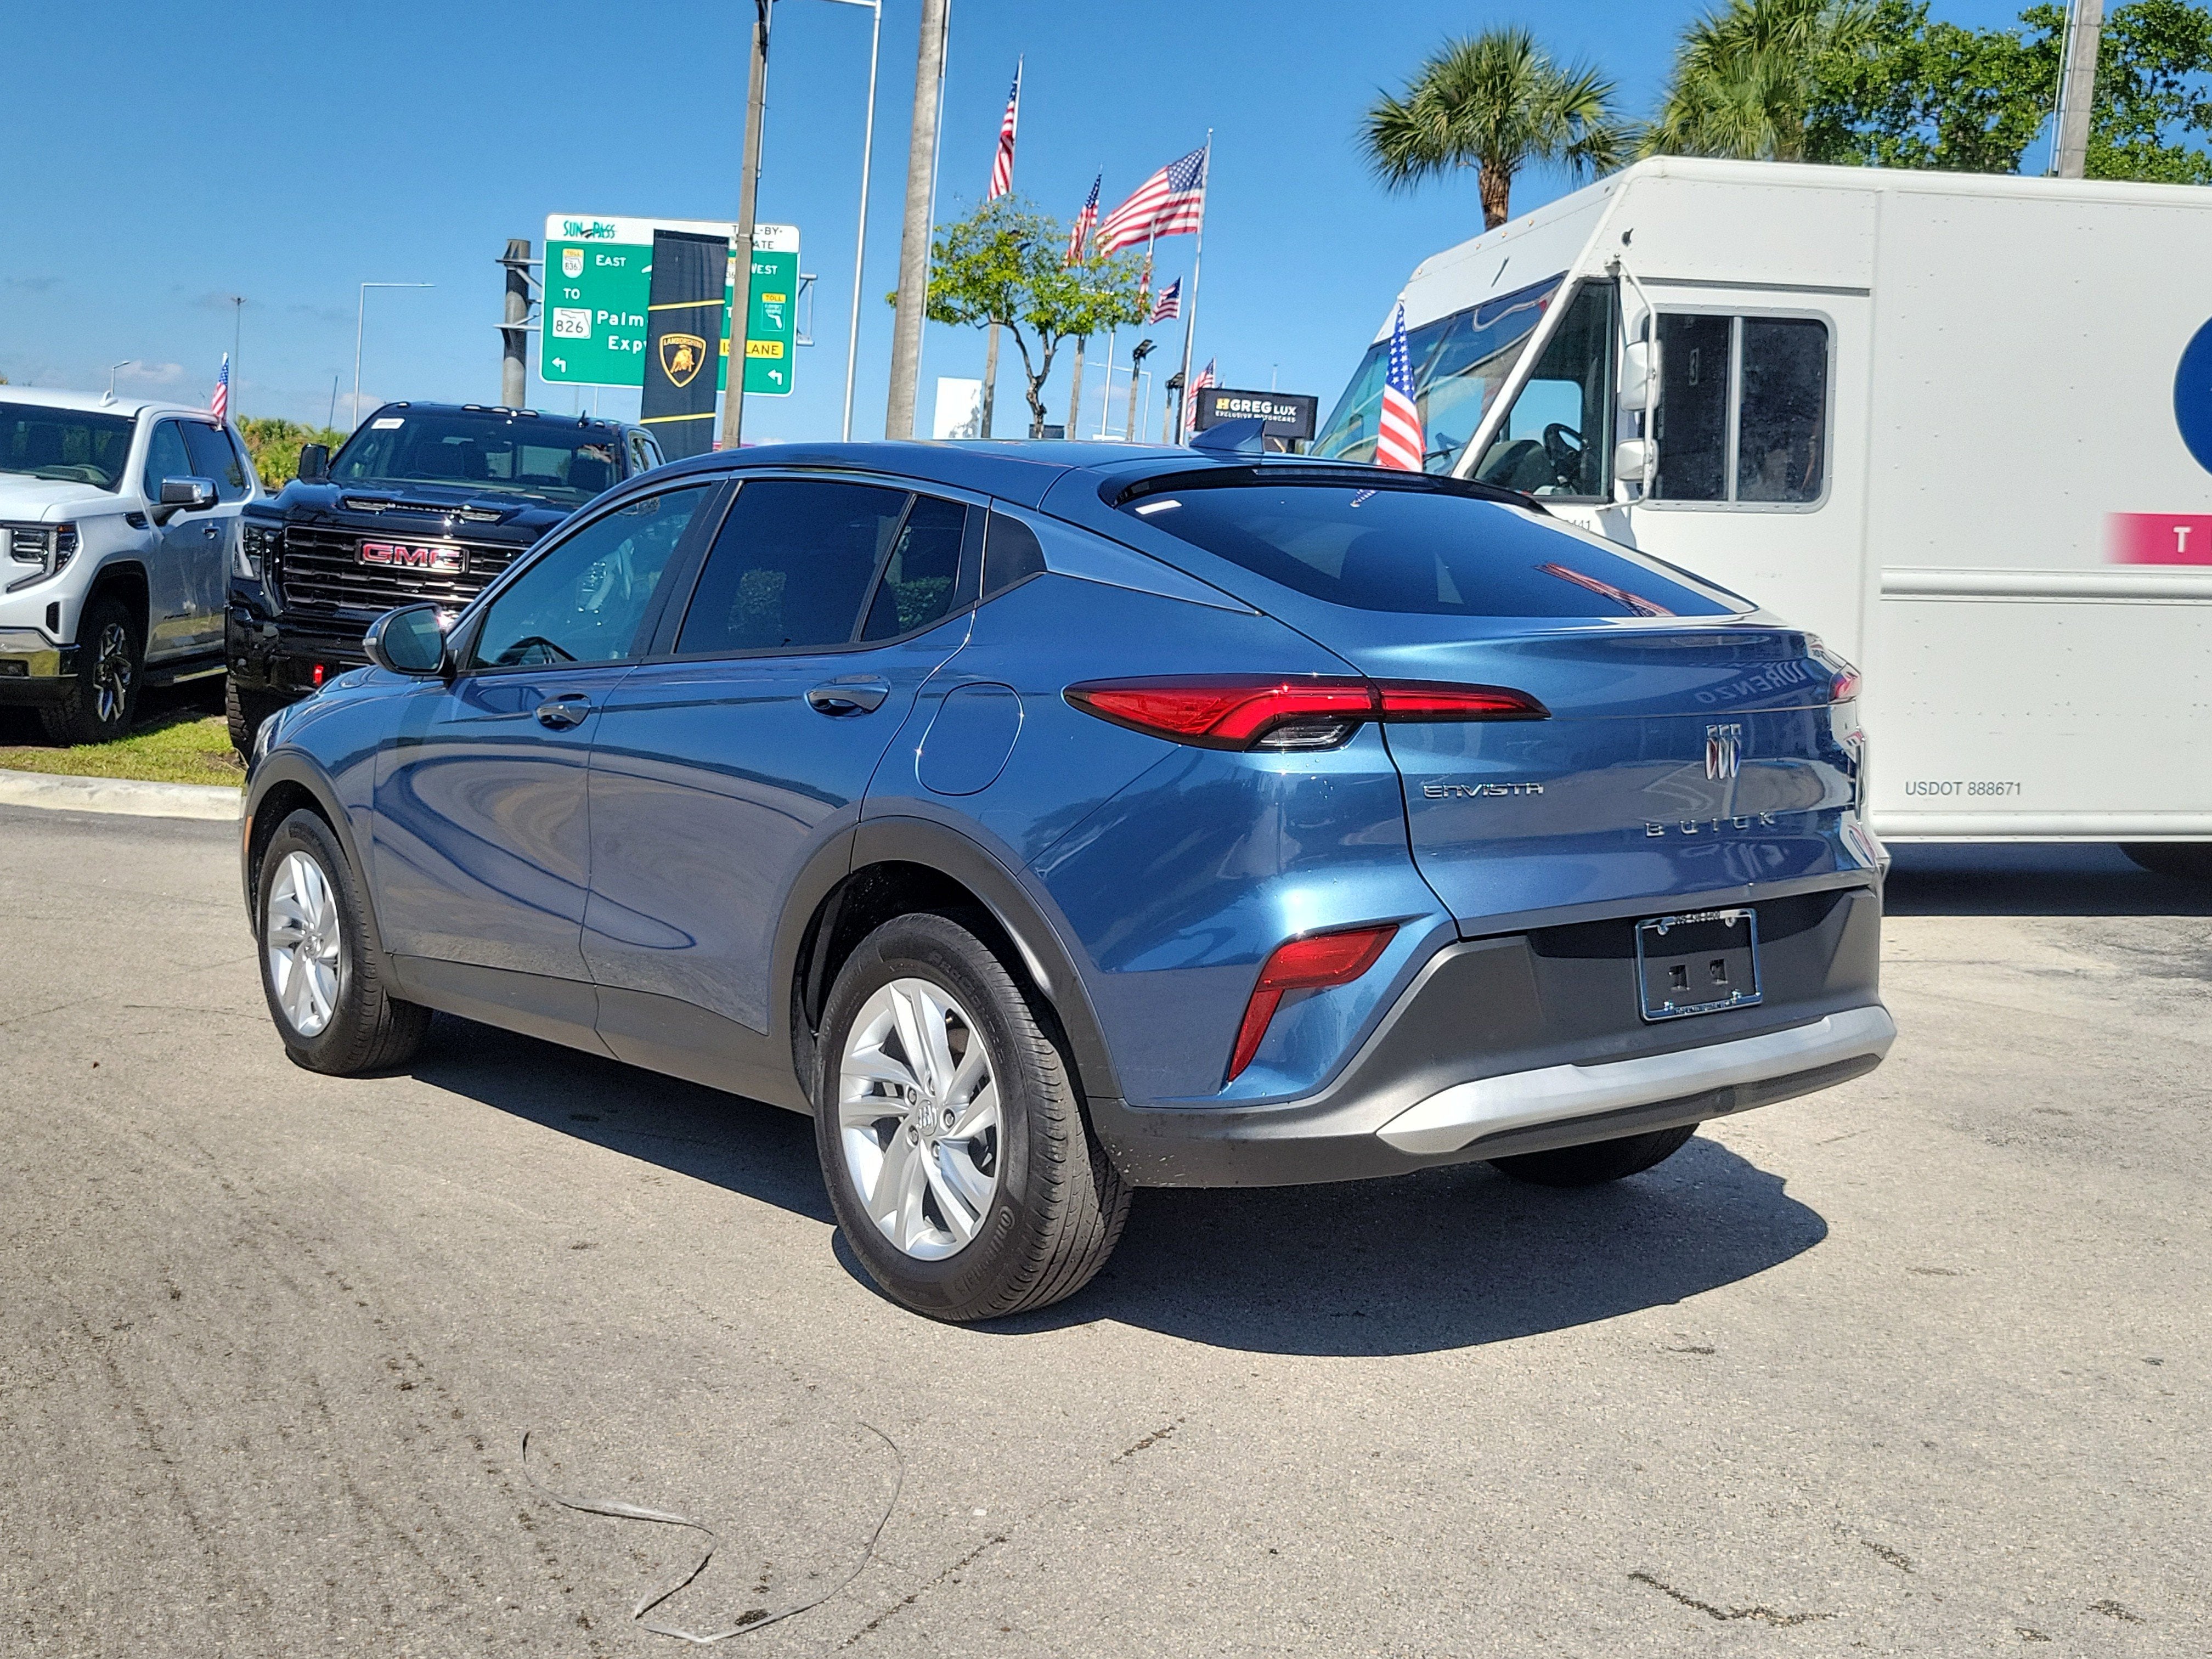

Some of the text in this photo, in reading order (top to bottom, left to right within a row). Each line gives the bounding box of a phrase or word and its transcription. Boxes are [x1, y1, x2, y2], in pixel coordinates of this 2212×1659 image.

[752, 240, 774, 250] ATE
[565, 262, 578, 270] 836
[596, 254, 626, 267] EAST
[563, 287, 580, 300] TO
[597, 310, 647, 328] Palm
[556, 320, 584, 333] 826
[1273, 405, 1297, 416] LUX
[363, 543, 461, 568] GMC
[1424, 783, 1544, 798] ENVISTA
[1905, 781, 2021, 796] USDOT 888671
[1645, 811, 1775, 837] BUICK
